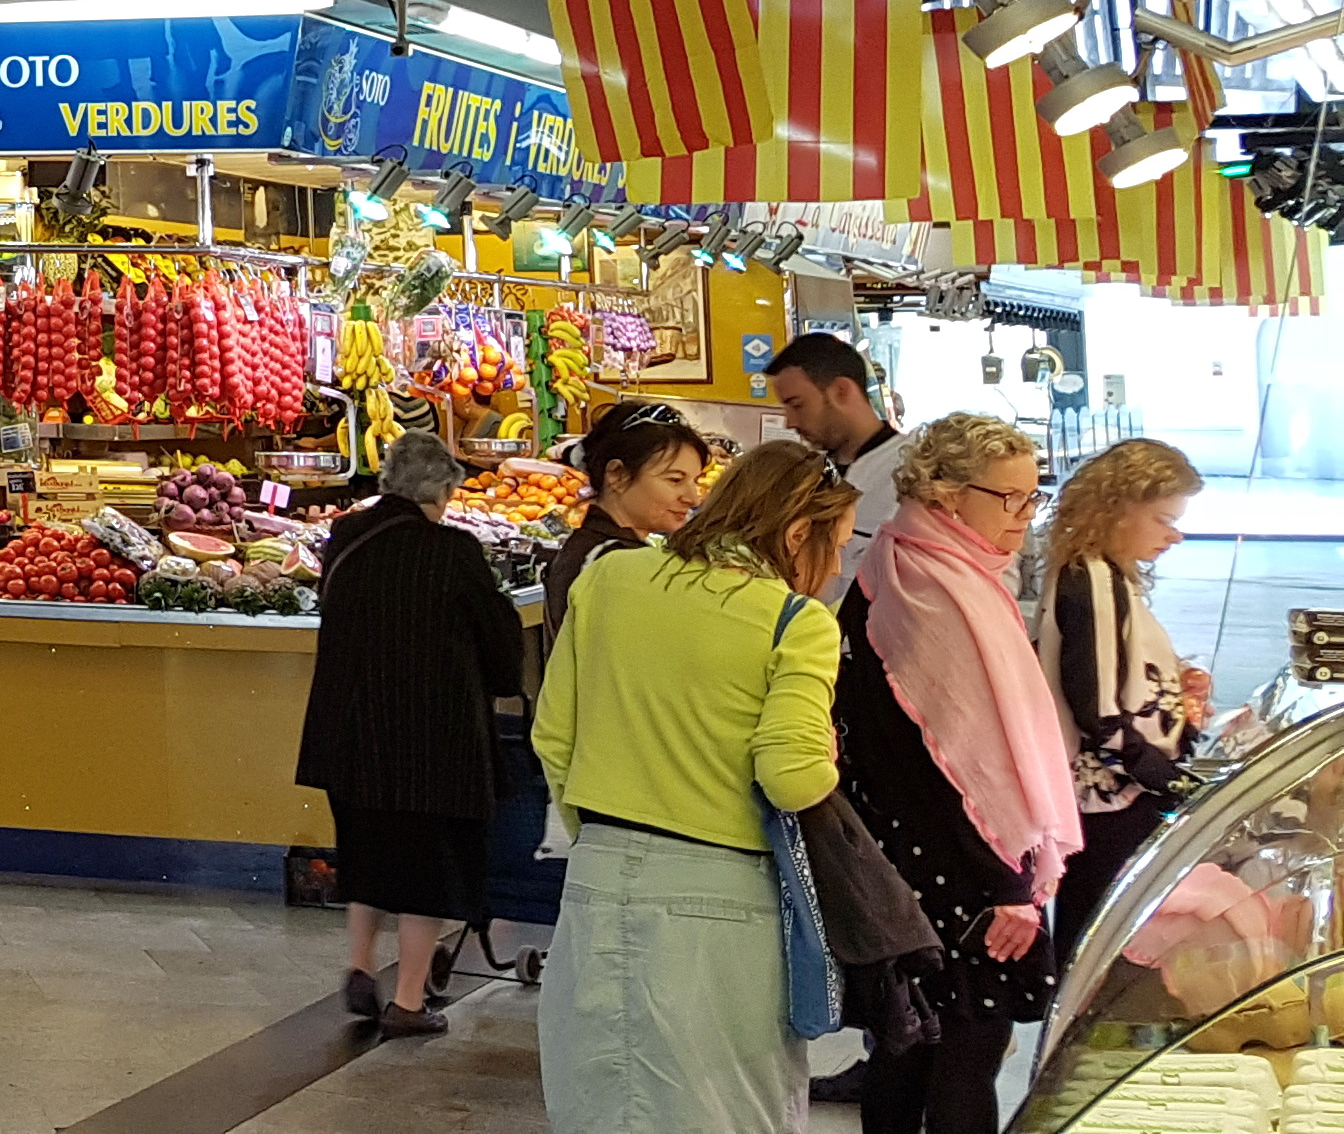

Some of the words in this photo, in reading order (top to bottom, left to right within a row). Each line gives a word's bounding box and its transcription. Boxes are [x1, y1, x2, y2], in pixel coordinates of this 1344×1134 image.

[359, 69, 391, 106] SOTO
[59, 99, 259, 137] VERDURES
[412, 80, 502, 163] FRUITES
